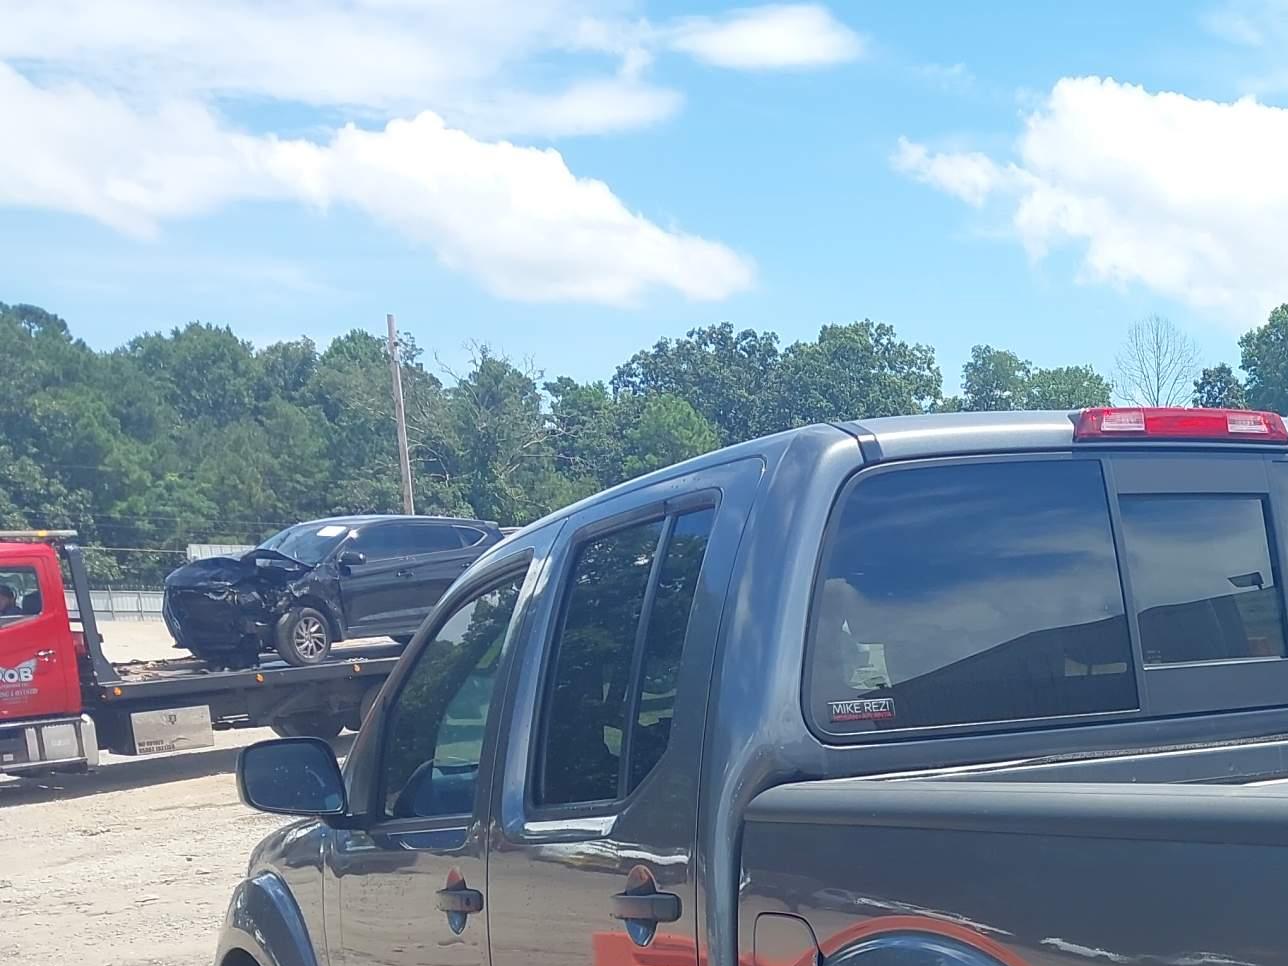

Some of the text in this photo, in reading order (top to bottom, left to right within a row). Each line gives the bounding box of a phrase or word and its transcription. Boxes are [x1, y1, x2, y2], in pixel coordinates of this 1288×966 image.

[0, 668, 33, 683] OB
[833, 701, 890, 714] MIKE REZI
